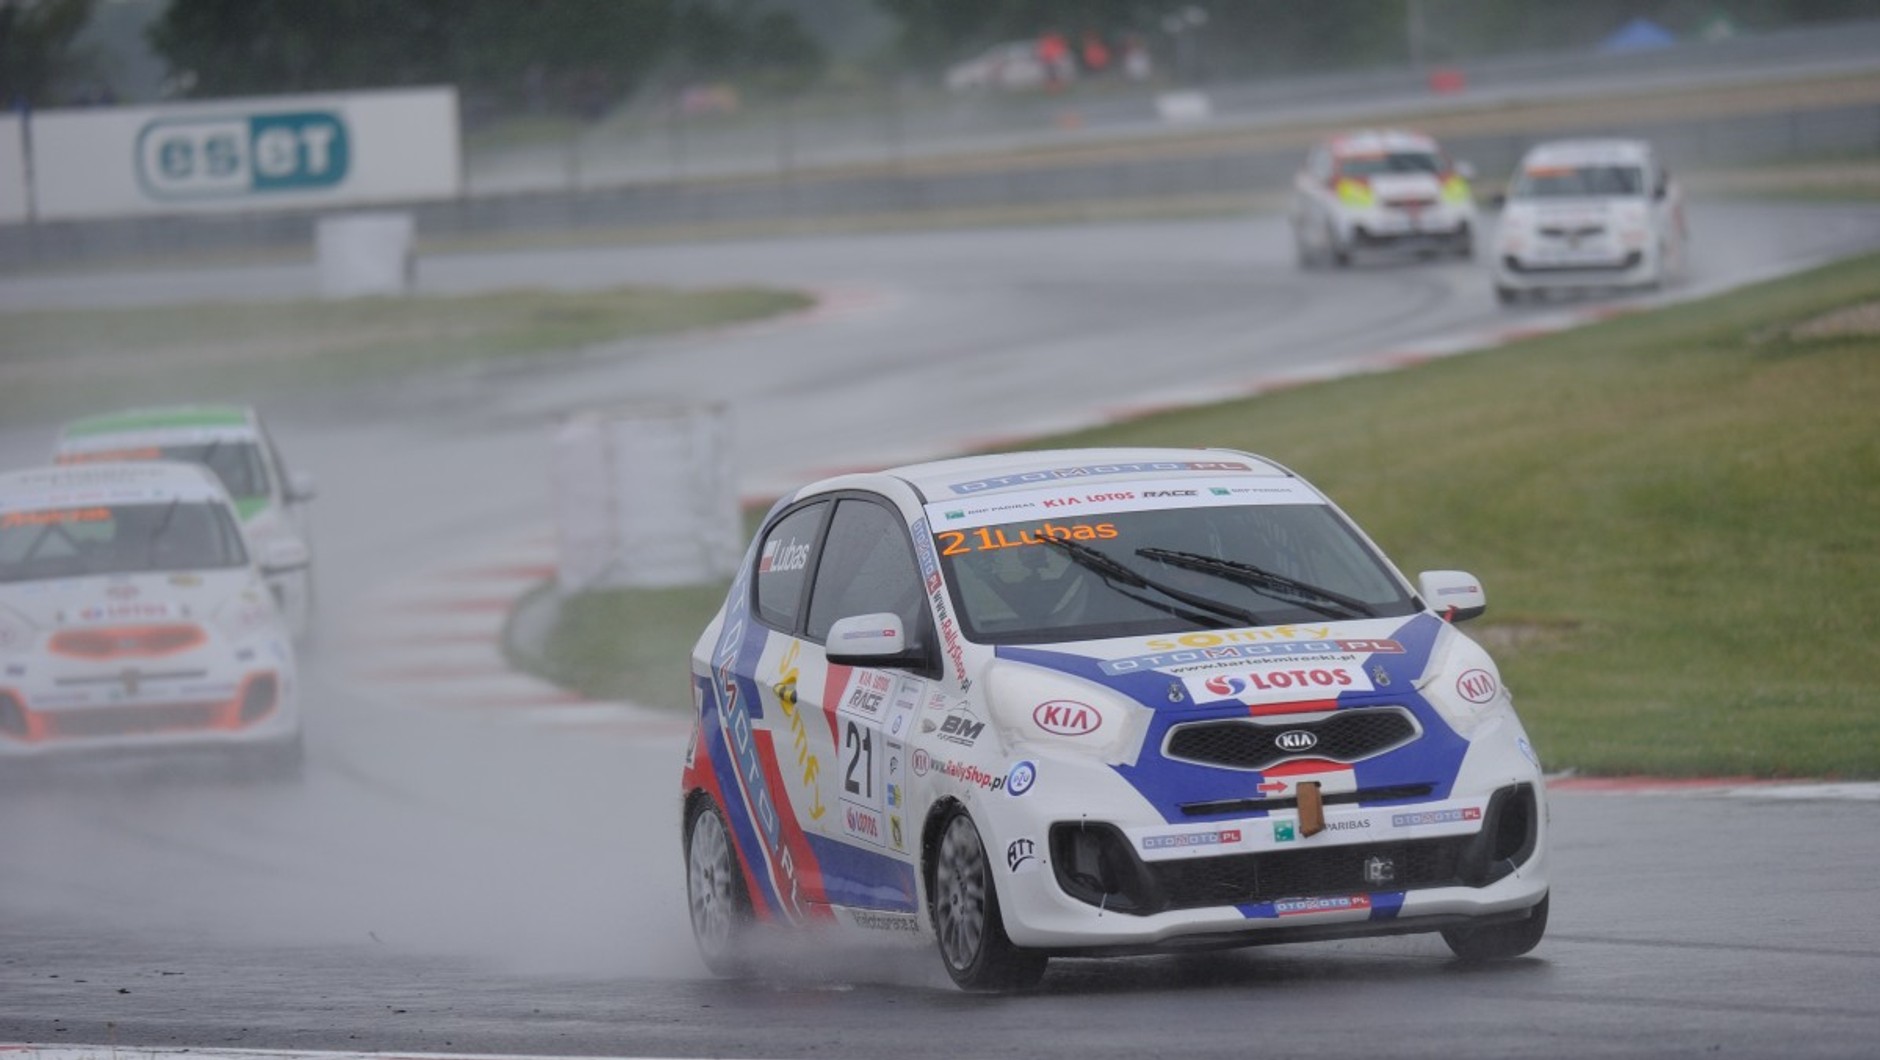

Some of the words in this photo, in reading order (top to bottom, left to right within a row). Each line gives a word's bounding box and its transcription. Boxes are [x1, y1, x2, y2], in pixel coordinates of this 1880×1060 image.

[1043, 497, 1081, 508] KIA
[1086, 491, 1135, 503] LOTOS
[1142, 489, 1198, 498] RACE
[770, 537, 810, 572] Lubas
[932, 590, 972, 694] www.RallyShop.pl
[1146, 625, 1331, 650] somfy
[1112, 640, 1395, 671] OTOMOTO.PL
[1252, 668, 1353, 690] LOTOS
[1462, 674, 1494, 699] KIA
[849, 689, 884, 712] RACE
[939, 714, 985, 740] BM
[1043, 705, 1088, 730] KIA
[845, 720, 872, 798] 21
[930, 758, 1008, 792] www.RallyShop.pl
[1394, 808, 1481, 827] OTOMOTO.PL
[1144, 831, 1240, 848] OTOMOTO.PL
[1007, 838, 1035, 868] ATT
